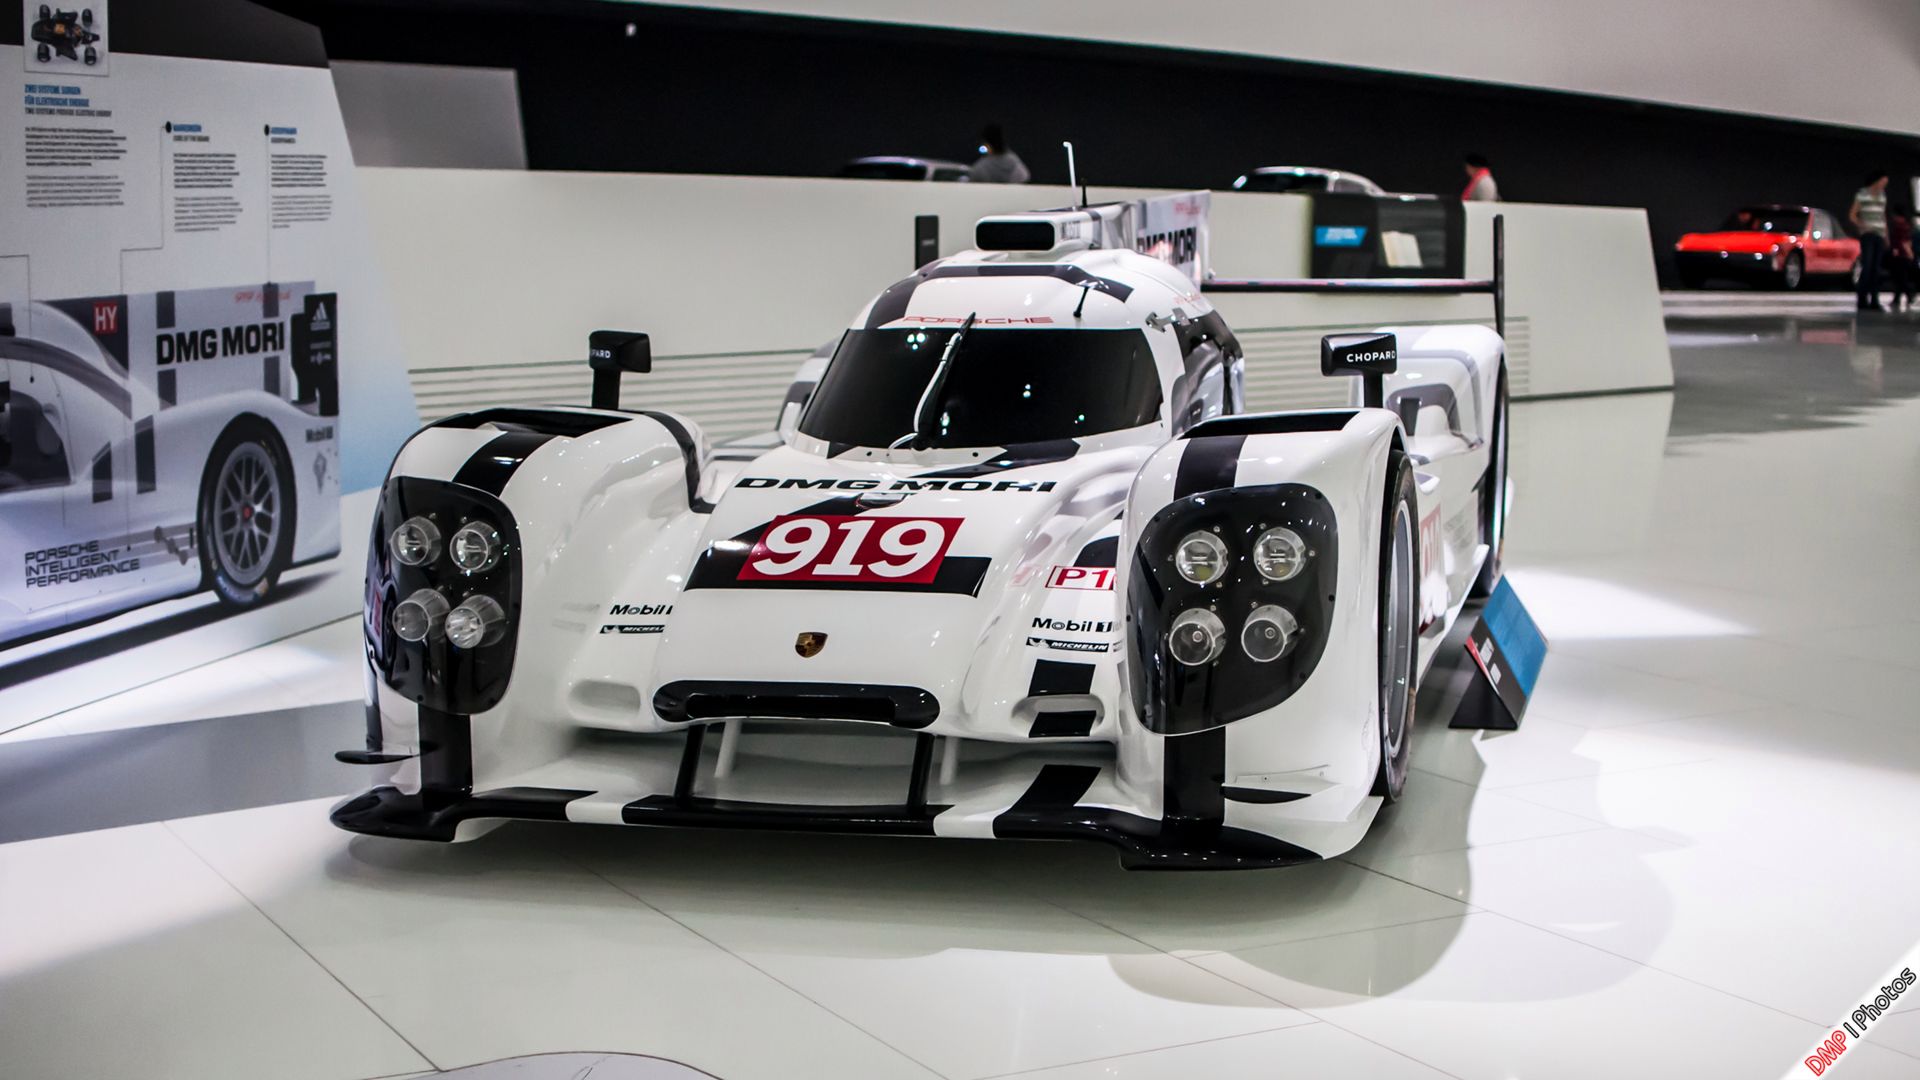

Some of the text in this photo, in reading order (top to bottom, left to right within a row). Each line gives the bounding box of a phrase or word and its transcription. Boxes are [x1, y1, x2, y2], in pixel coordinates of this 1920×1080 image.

[95, 305, 118, 331] HY
[903, 315, 1054, 324] PORSCHE
[156, 321, 285, 365] DMG MORI
[590, 349, 611, 359] PARD
[1346, 350, 1396, 362] CHOPARD
[734, 477, 1058, 492] DMG MORI
[25, 540, 100, 565] PORSCHE
[752, 518, 946, 578] 919
[26, 549, 119, 577] INTELLIGENT
[26, 558, 140, 588] PERFORMANCE
[1055, 568, 1110, 588] P1
[609, 604, 667, 615] Mobil
[1031, 617, 1093, 632] Mobil
[1051, 641, 1109, 651] MICHELIN
